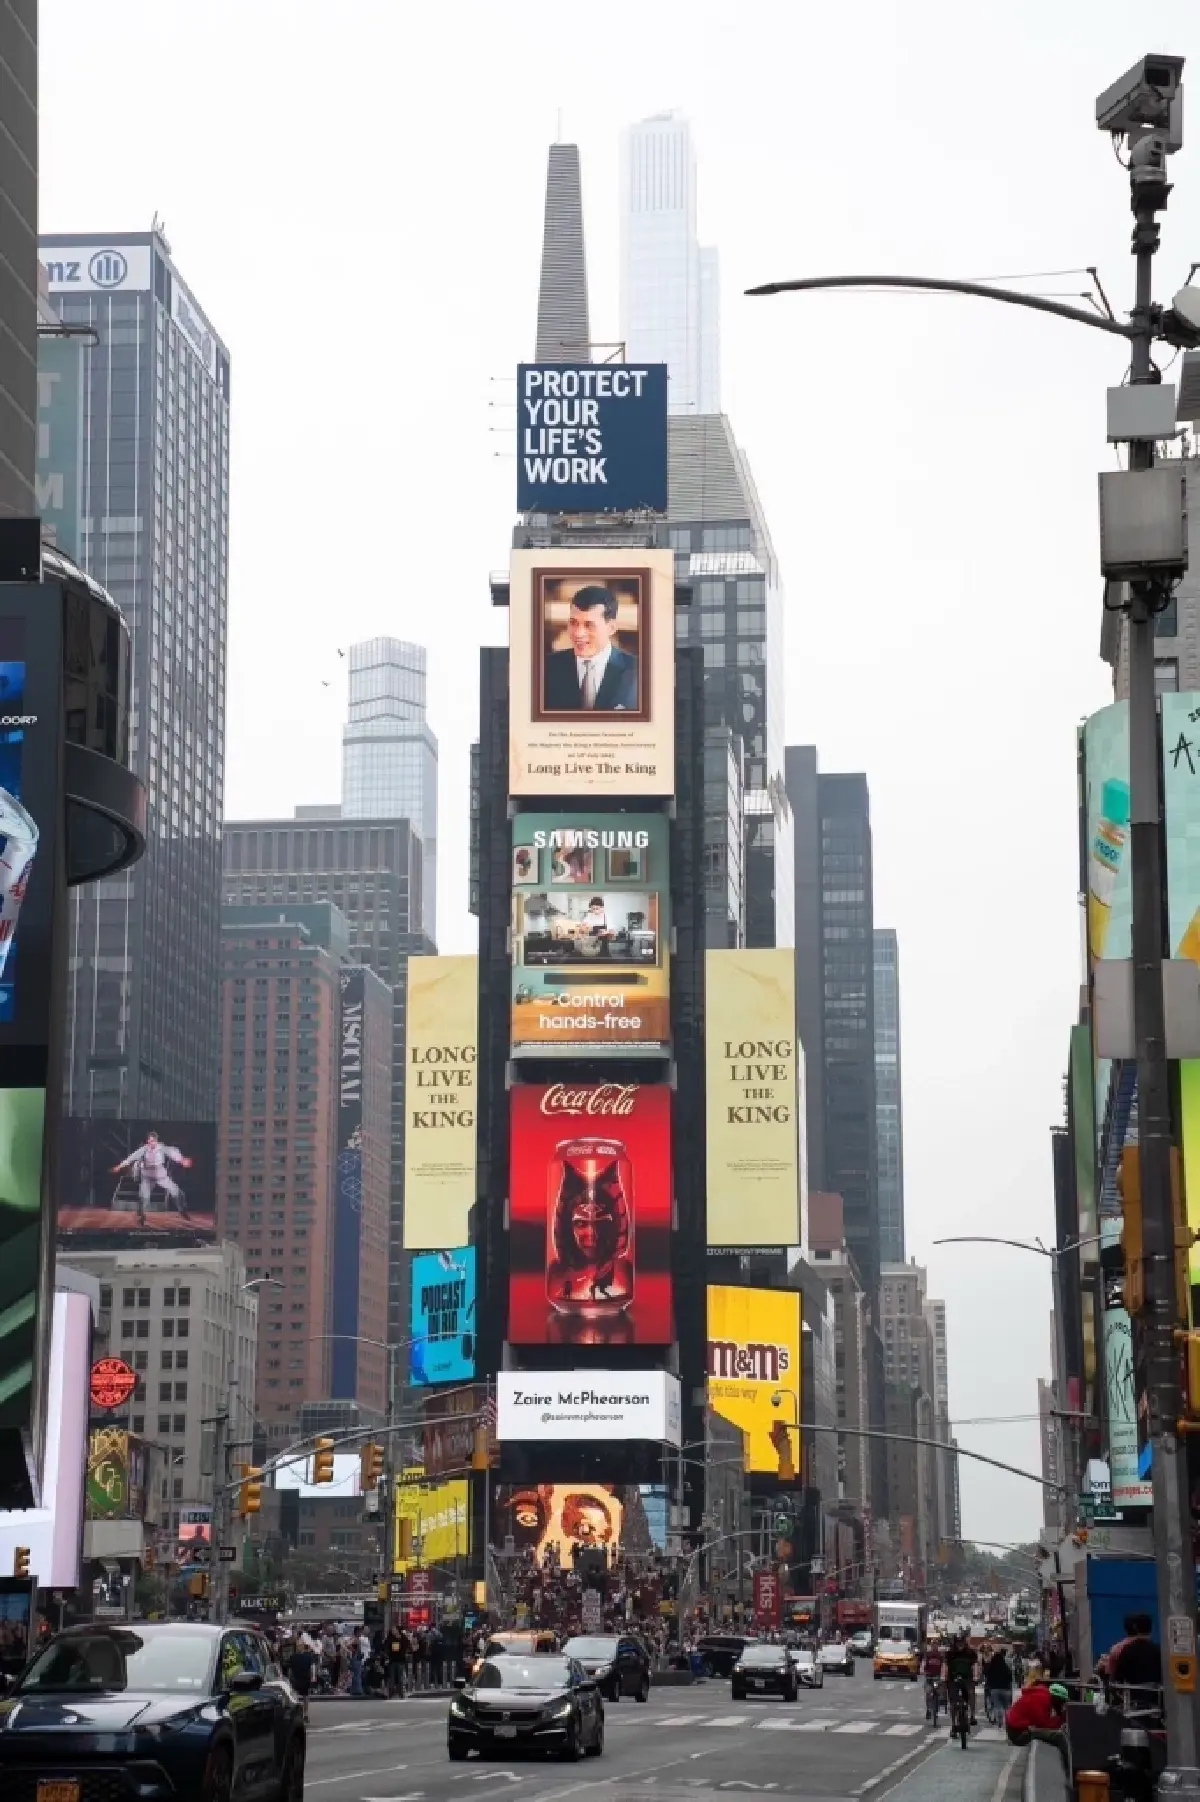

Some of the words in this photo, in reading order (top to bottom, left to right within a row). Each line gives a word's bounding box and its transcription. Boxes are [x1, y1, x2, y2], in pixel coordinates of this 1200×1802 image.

[525, 371, 648, 397] PROTECT
[524, 399, 600, 425] YOUR
[525, 428, 603, 455] LIFE'S
[524, 458, 607, 484] WORK
[0, 715, 38, 725] OOR?
[527, 763, 561, 777] Long
[564, 763, 593, 775] Live
[595, 763, 621, 775] The
[624, 763, 657, 776] King
[534, 831, 648, 848] SAMSUNG
[558, 992, 624, 1008] Control
[539, 1014, 641, 1029] hands-free
[411, 1046, 477, 1063] LONG
[724, 1040, 793, 1059] LONG
[416, 1070, 472, 1087] LIVE
[730, 1064, 788, 1081] LIVE
[428, 1093, 459, 1103] THE
[743, 1088, 774, 1099] THE
[412, 1111, 475, 1129] KING
[727, 1106, 790, 1124] KING
[513, 1391, 552, 1405] Zaire
[557, 1390, 649, 1405] McPhearson
[759, 1575, 776, 1609] tkts
